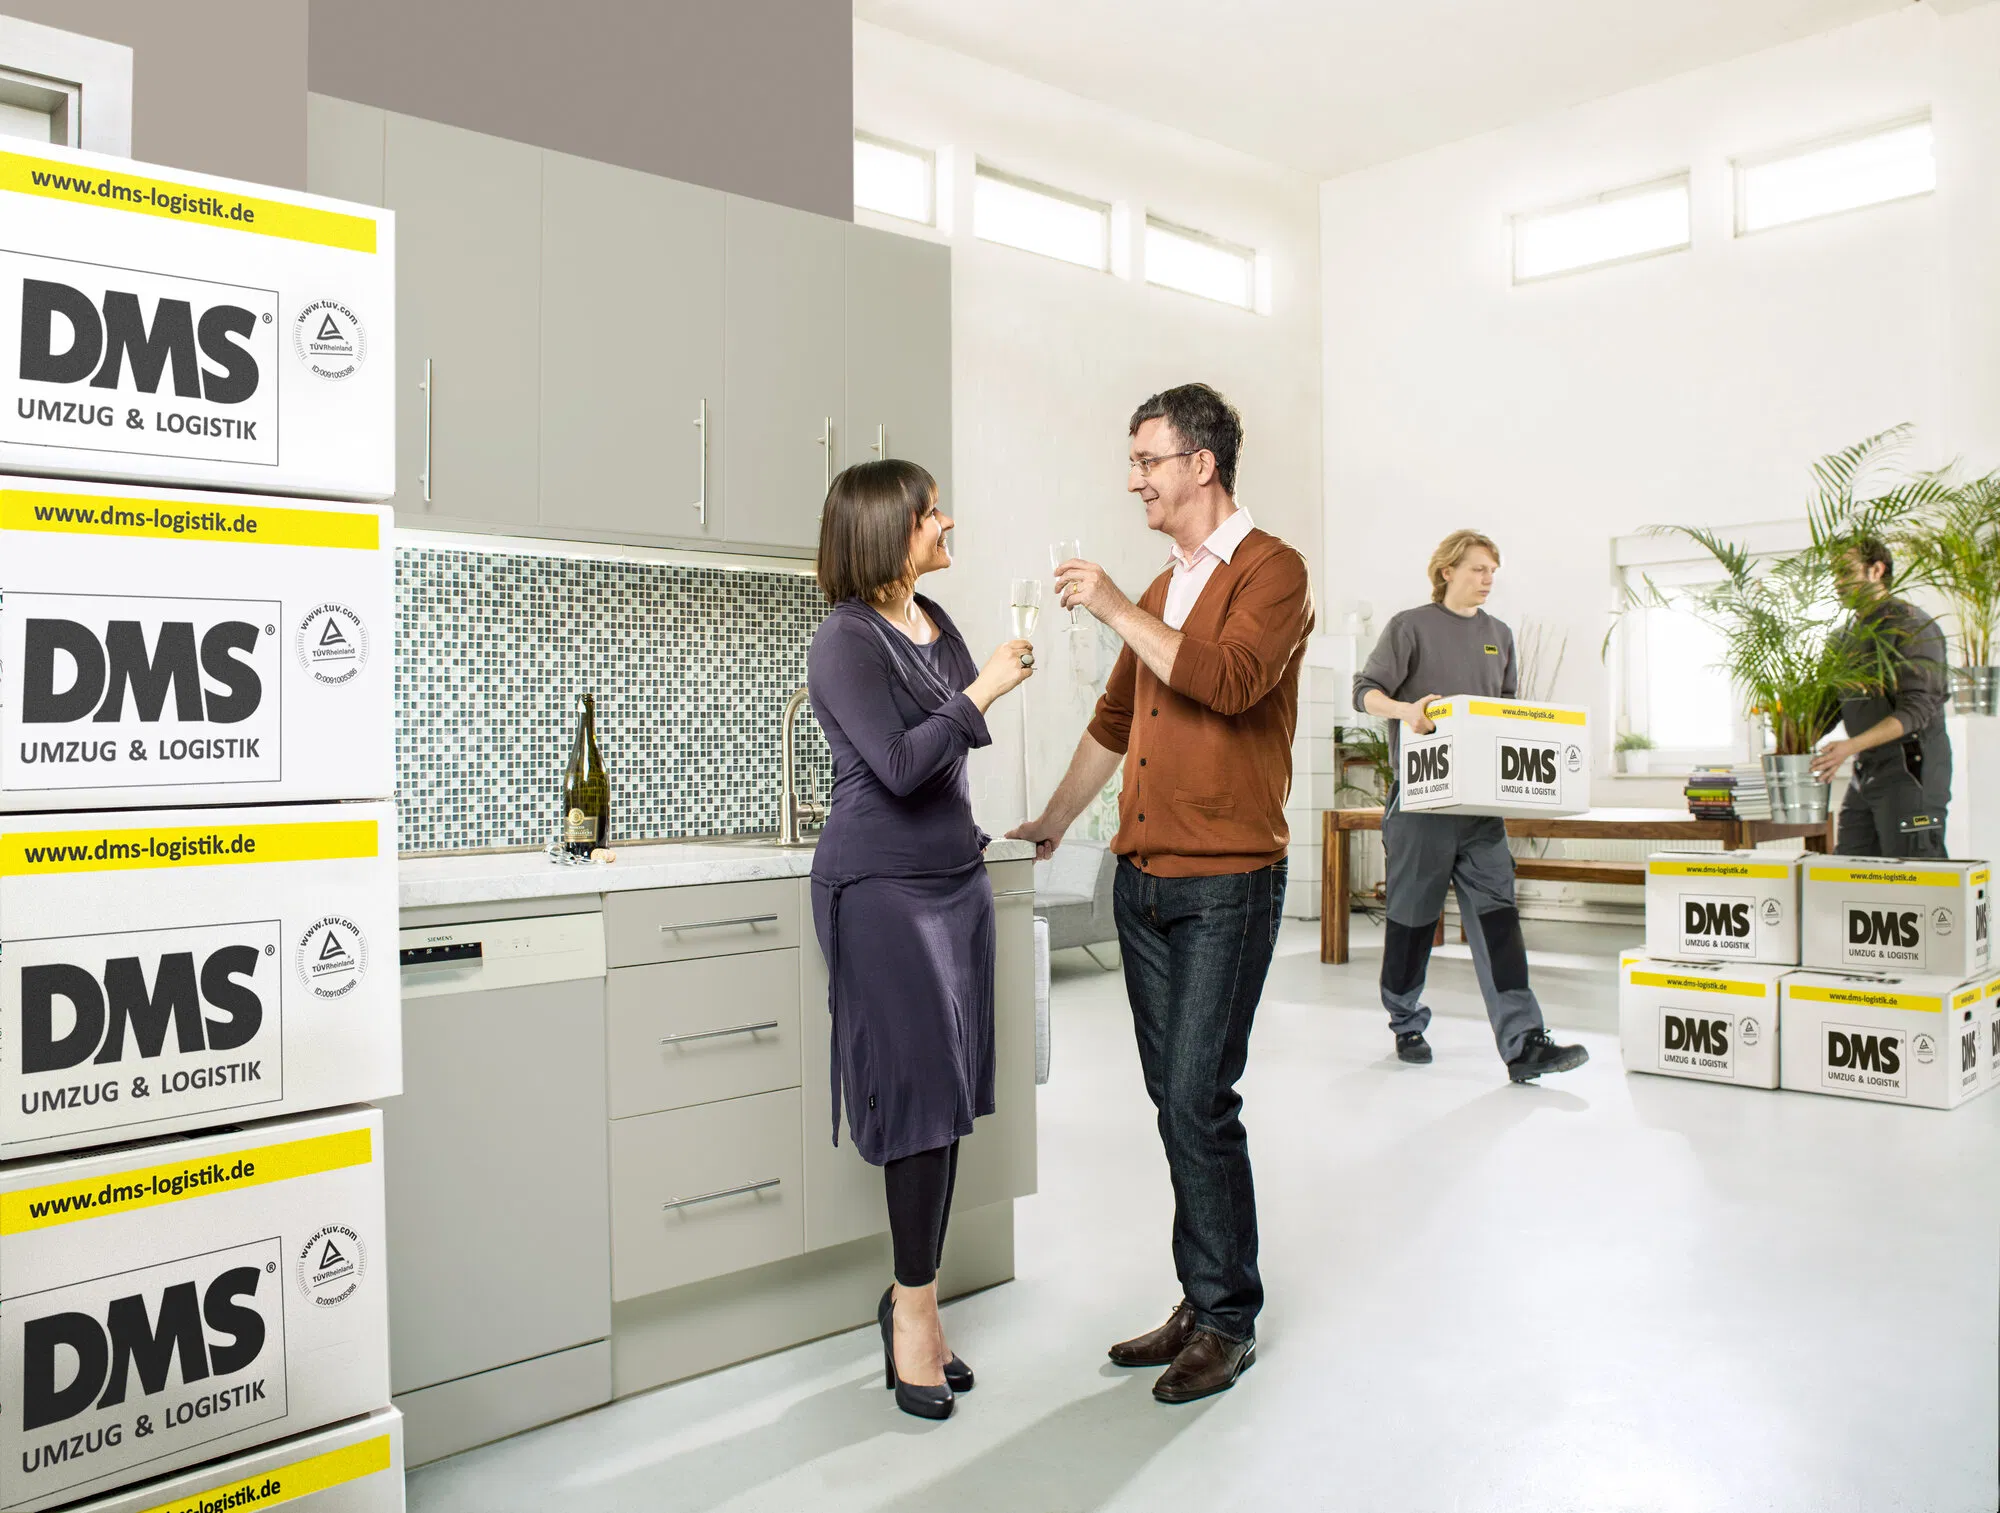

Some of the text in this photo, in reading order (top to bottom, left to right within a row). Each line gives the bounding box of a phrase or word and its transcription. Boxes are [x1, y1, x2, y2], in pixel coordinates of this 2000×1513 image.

[31, 171, 255, 223] www.dms-logistik.de
[298, 300, 358, 325] www.tuv.com
[18, 397, 257, 441] UMZUG & LOGISTIK
[34, 505, 257, 534] www.dms-logistik.de
[301, 604, 361, 631] www.tuv.com
[1502, 708, 1555, 720] www.dms-logistik.de
[20, 738, 260, 764] UMZUG & LOGISTIK
[1501, 784, 1556, 797] UMZUG & LOGISTIK
[24, 833, 256, 863] www.dms-logistik.de
[300, 917, 360, 947] www.tuv.com
[1685, 939, 1750, 950] UMZUG & LOGISTIK
[1848, 948, 1919, 961] UMZUG & LOGISTIK
[1664, 1054, 1728, 1069] UMZUG & LOGISTIK
[21, 1060, 262, 1115] UMZUG & LOGISTIK
[1827, 1071, 1900, 1089] UMZUG & LOGISTIK
[29, 1159, 255, 1219] www.dms-logistik.de
[300, 1225, 358, 1259] www.tuv.com
[22, 1378, 266, 1474] UMZUG & LOGISTIK
